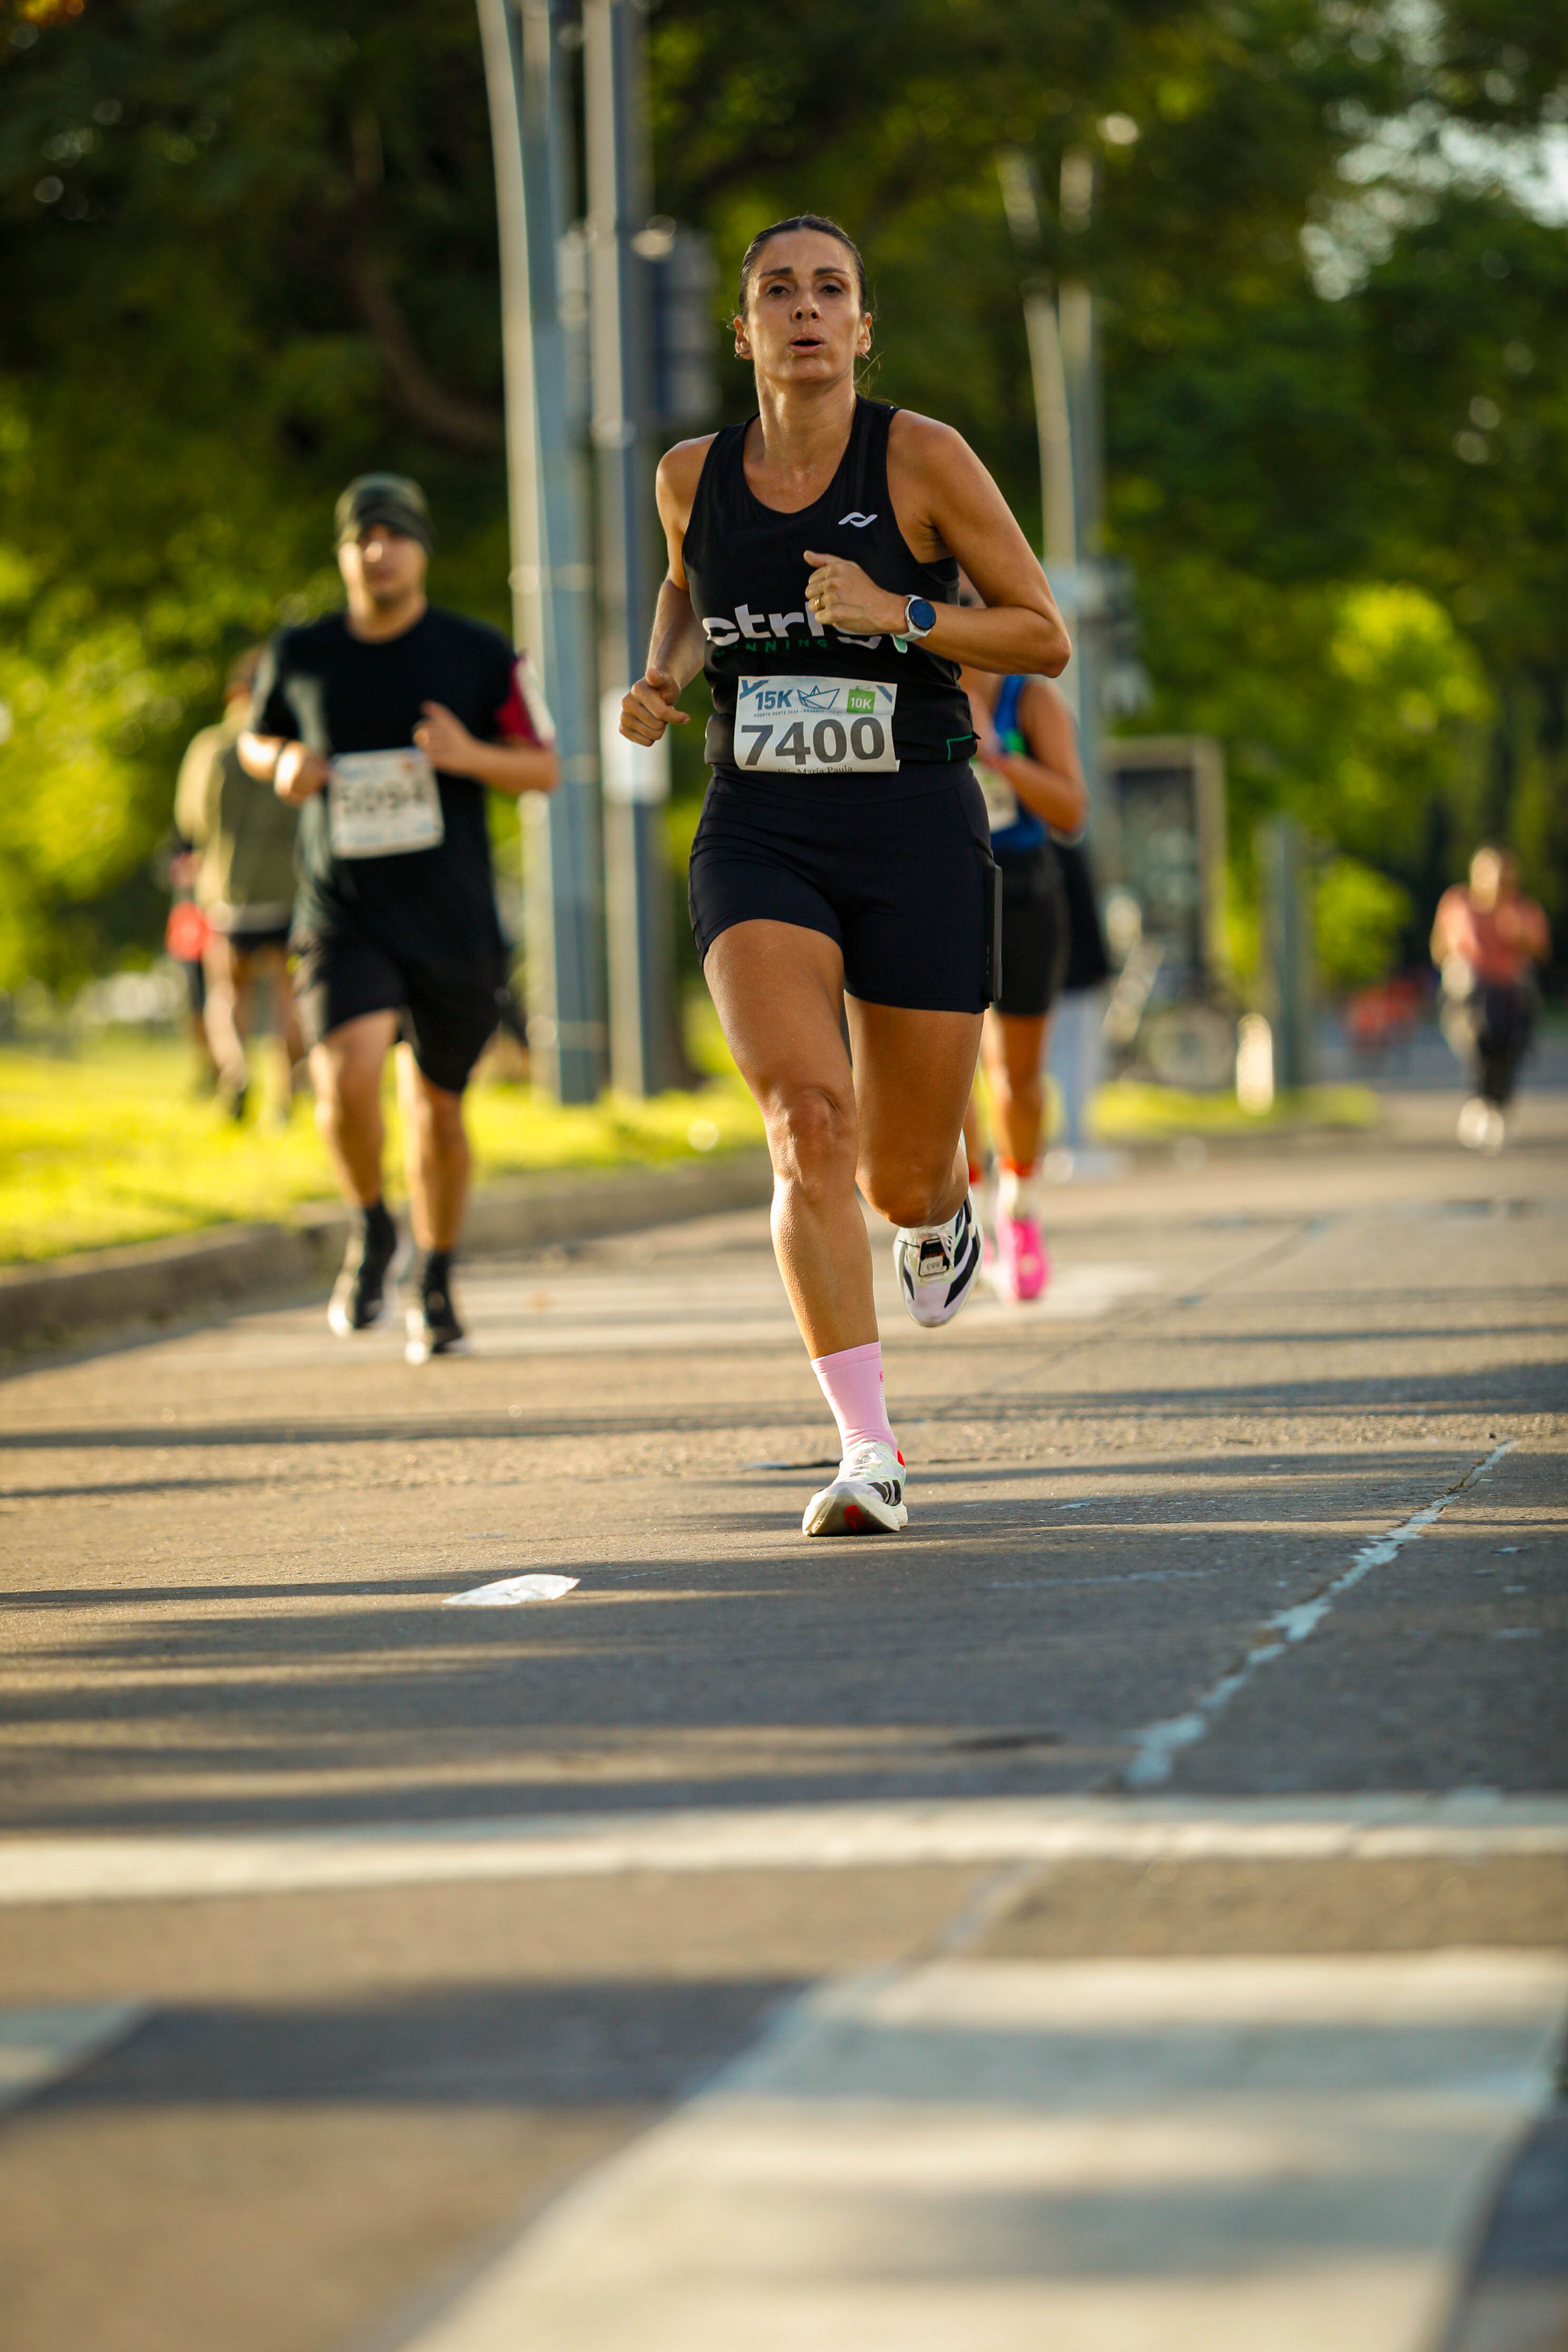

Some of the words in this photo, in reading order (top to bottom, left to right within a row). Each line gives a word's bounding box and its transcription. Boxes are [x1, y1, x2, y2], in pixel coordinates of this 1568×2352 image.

[756, 689, 792, 710] 15K
[850, 697, 872, 709] 10K
[741, 717, 885, 766] 7400
[827, 765, 852, 773] Paula
